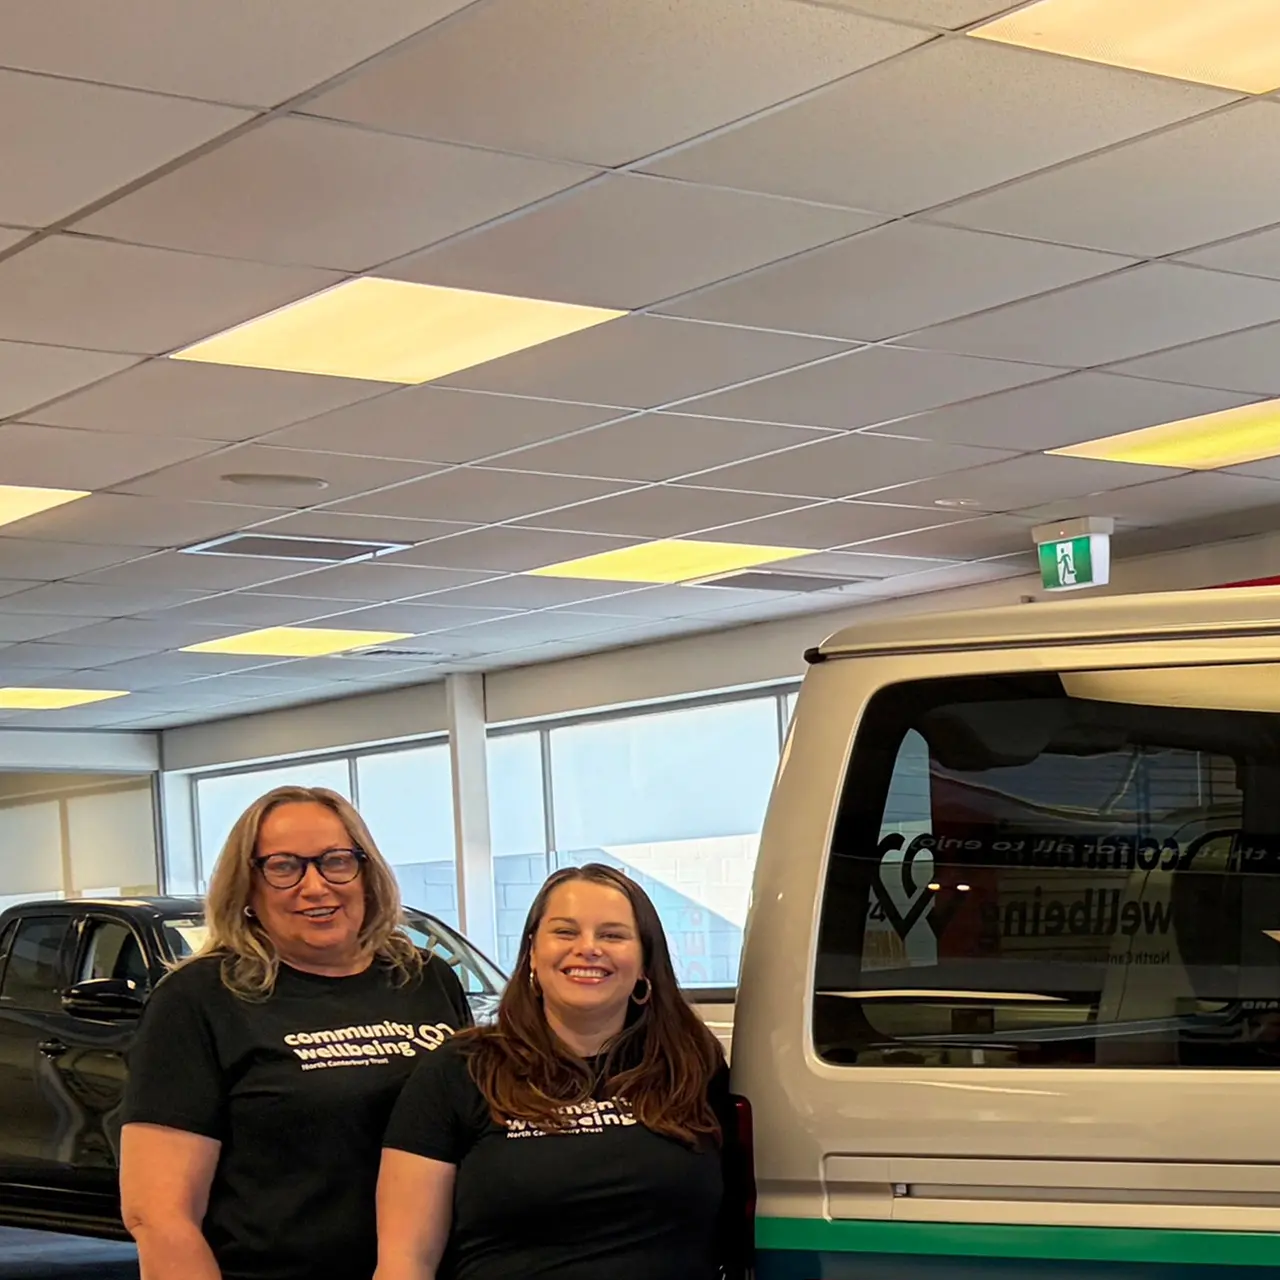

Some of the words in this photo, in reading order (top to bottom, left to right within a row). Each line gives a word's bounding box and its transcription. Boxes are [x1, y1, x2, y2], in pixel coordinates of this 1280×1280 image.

[284, 1020, 414, 1046] community
[293, 1040, 416, 1060] wellbeing
[301, 1061, 326, 1071] North
[327, 1059, 370, 1067] Canterbury
[507, 1130, 531, 1138] North
